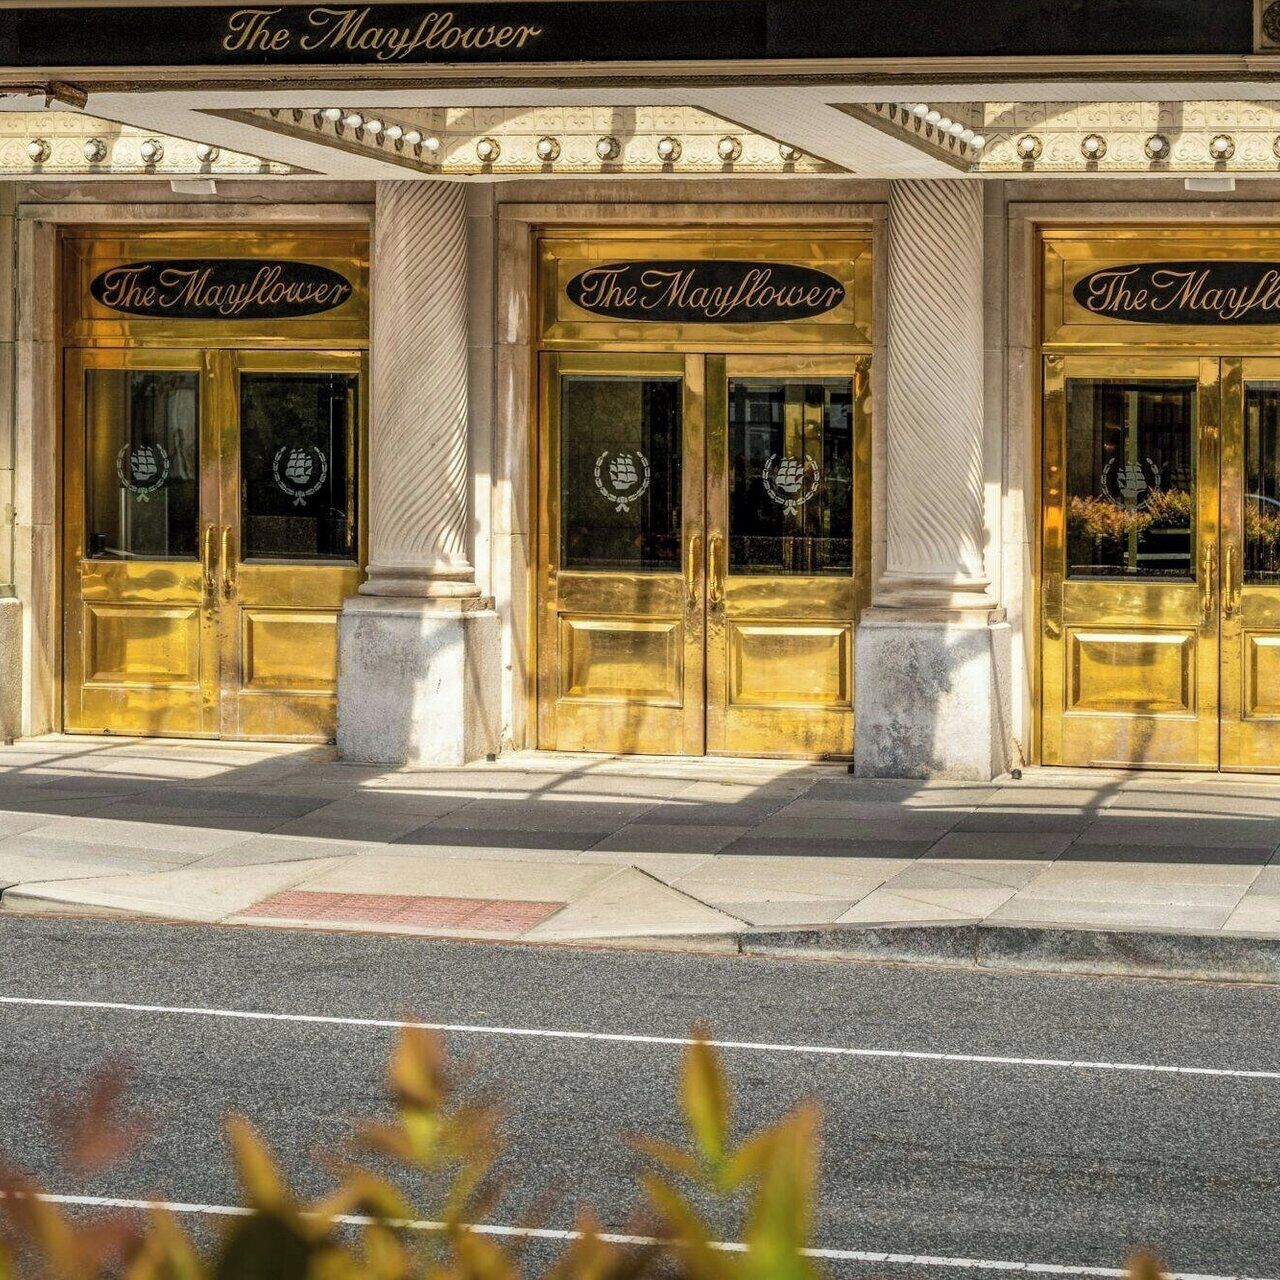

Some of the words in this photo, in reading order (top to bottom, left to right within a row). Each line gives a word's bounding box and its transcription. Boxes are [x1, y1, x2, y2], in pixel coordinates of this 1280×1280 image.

[221, 7, 291, 52] The
[299, 6, 543, 61] Mayflower
[102, 264, 155, 308] The
[158, 265, 351, 315] Mayflower
[580, 265, 638, 309] The
[640, 268, 844, 318] Mayflower
[1086, 266, 1148, 312] The
